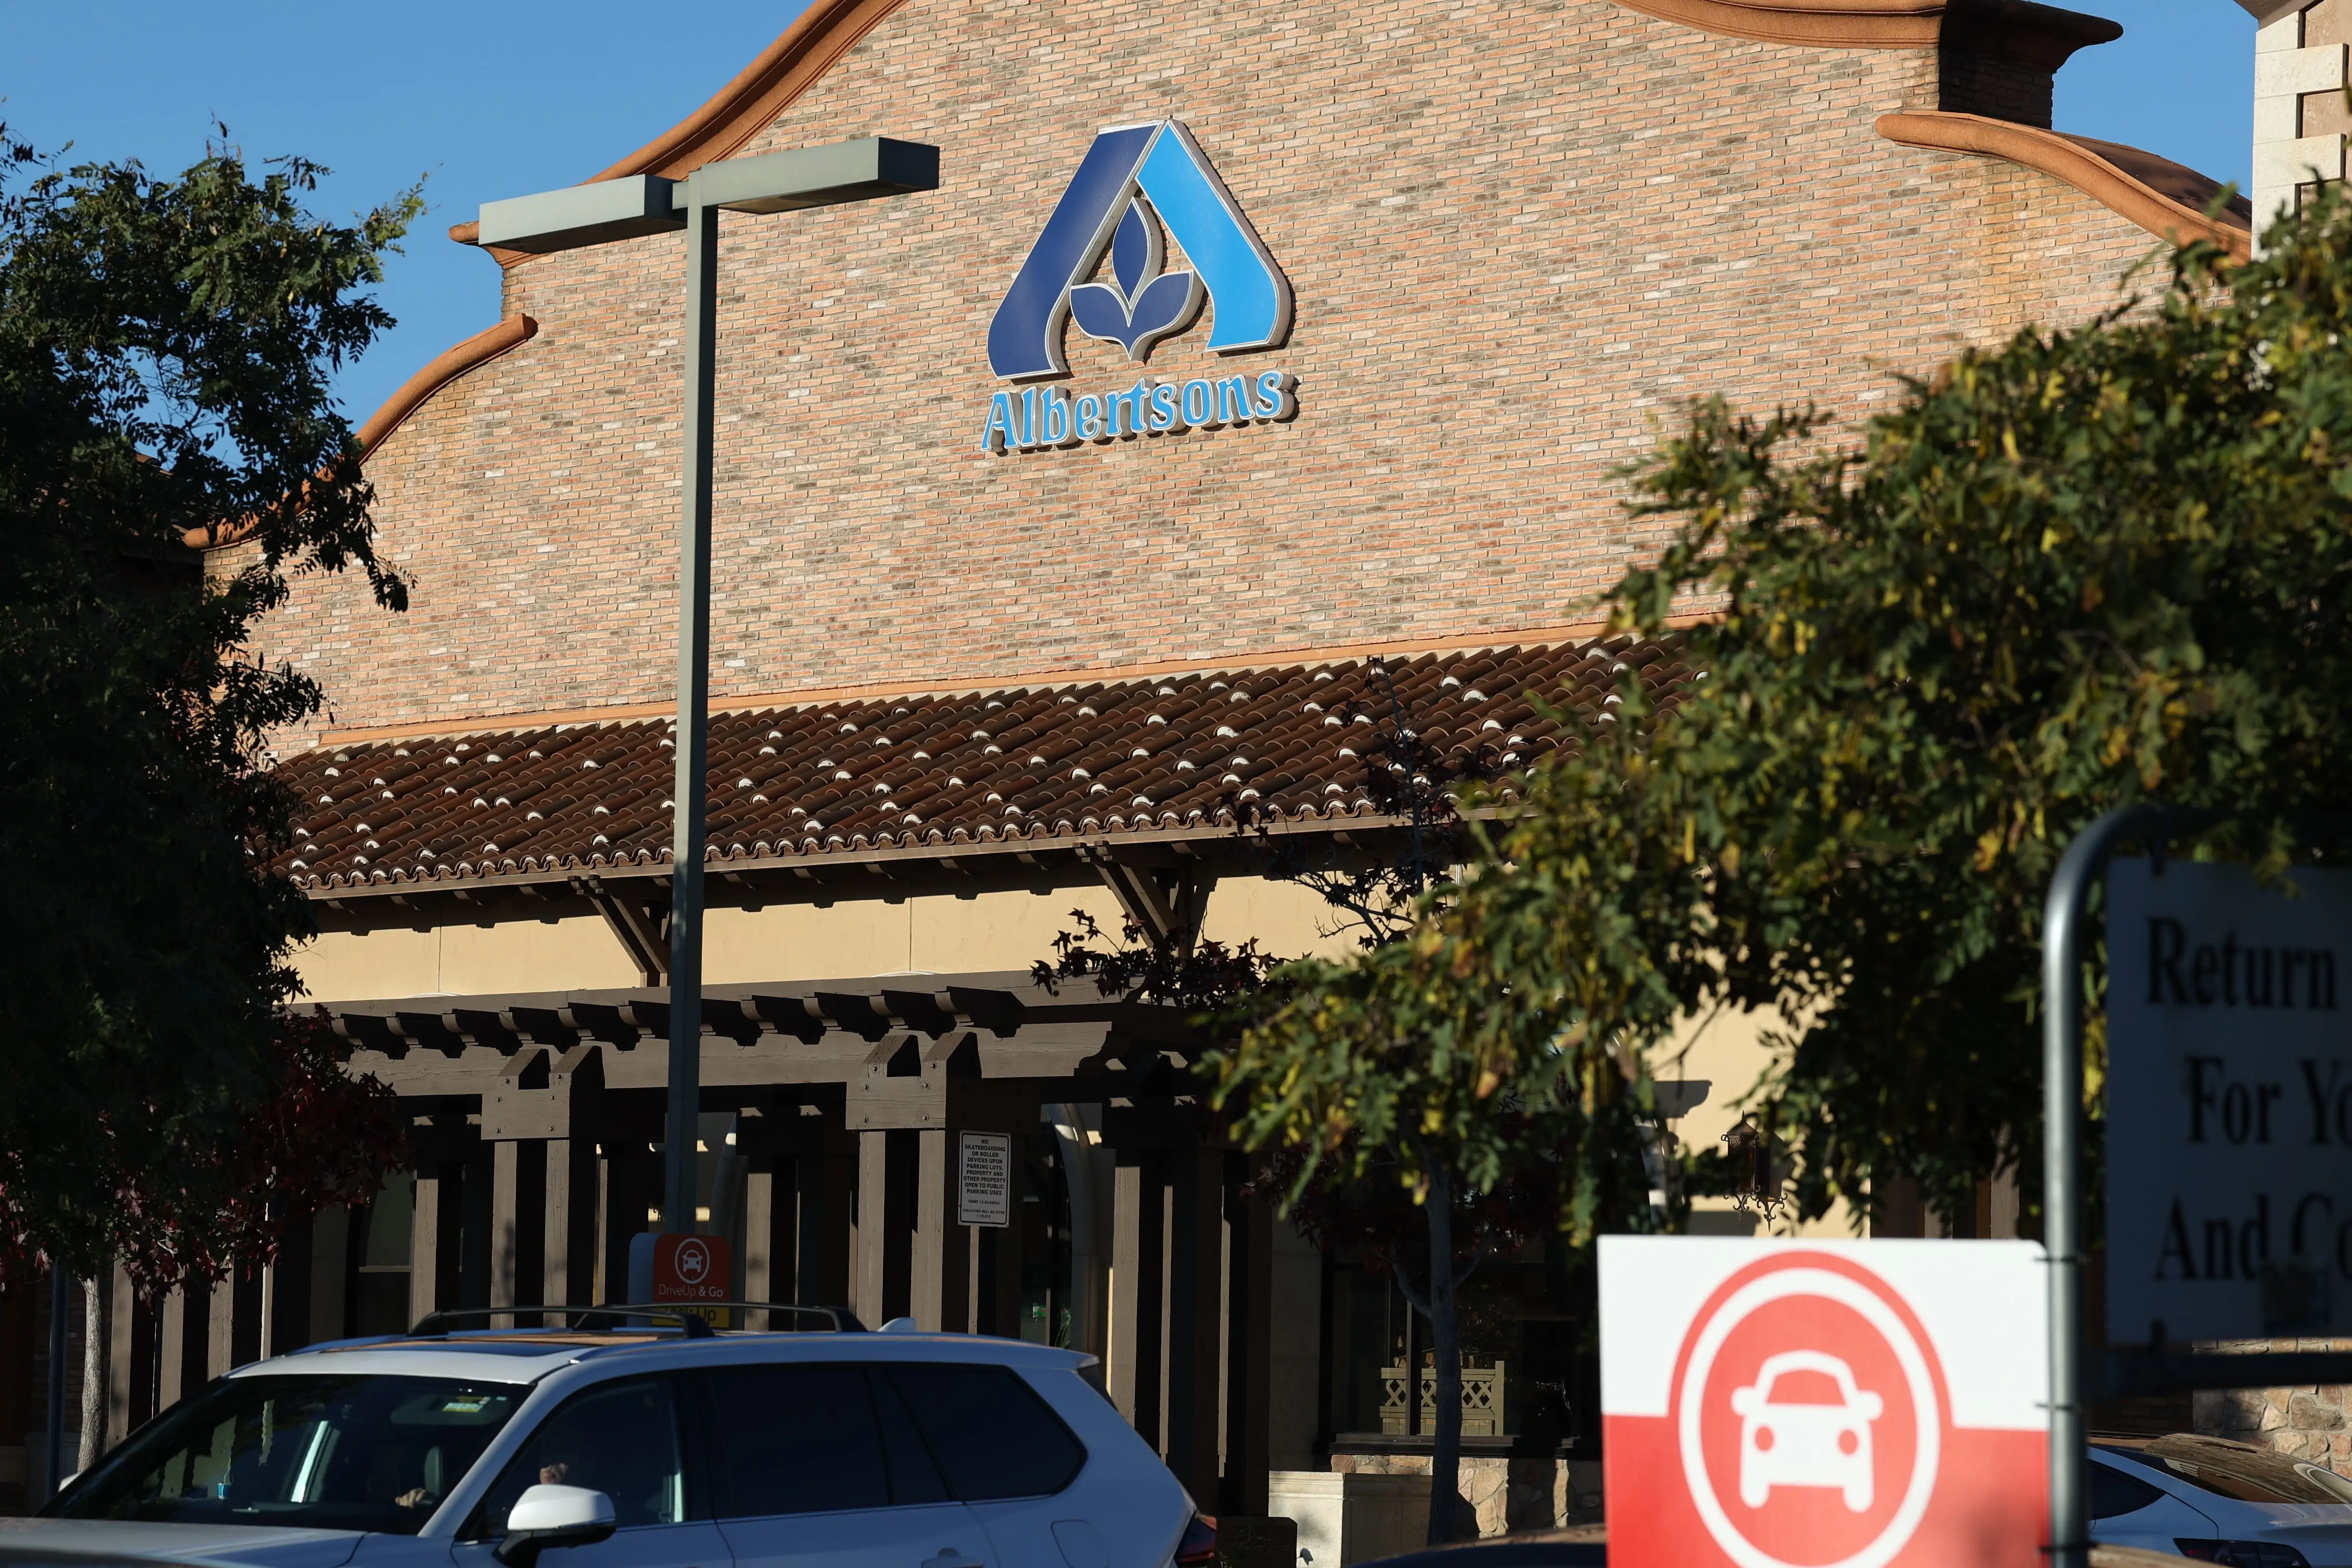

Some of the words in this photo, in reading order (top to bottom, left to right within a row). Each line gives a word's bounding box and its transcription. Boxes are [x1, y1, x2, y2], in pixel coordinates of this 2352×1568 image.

[980, 370, 1294, 452] Albertsons
[2146, 916, 2338, 1010] Return
[2186, 1055, 2282, 1145] For
[2153, 1194, 2270, 1281] And
[659, 1284, 696, 1299] DriveUp
[699, 1286, 705, 1297] &
[709, 1286, 723, 1297] Go
